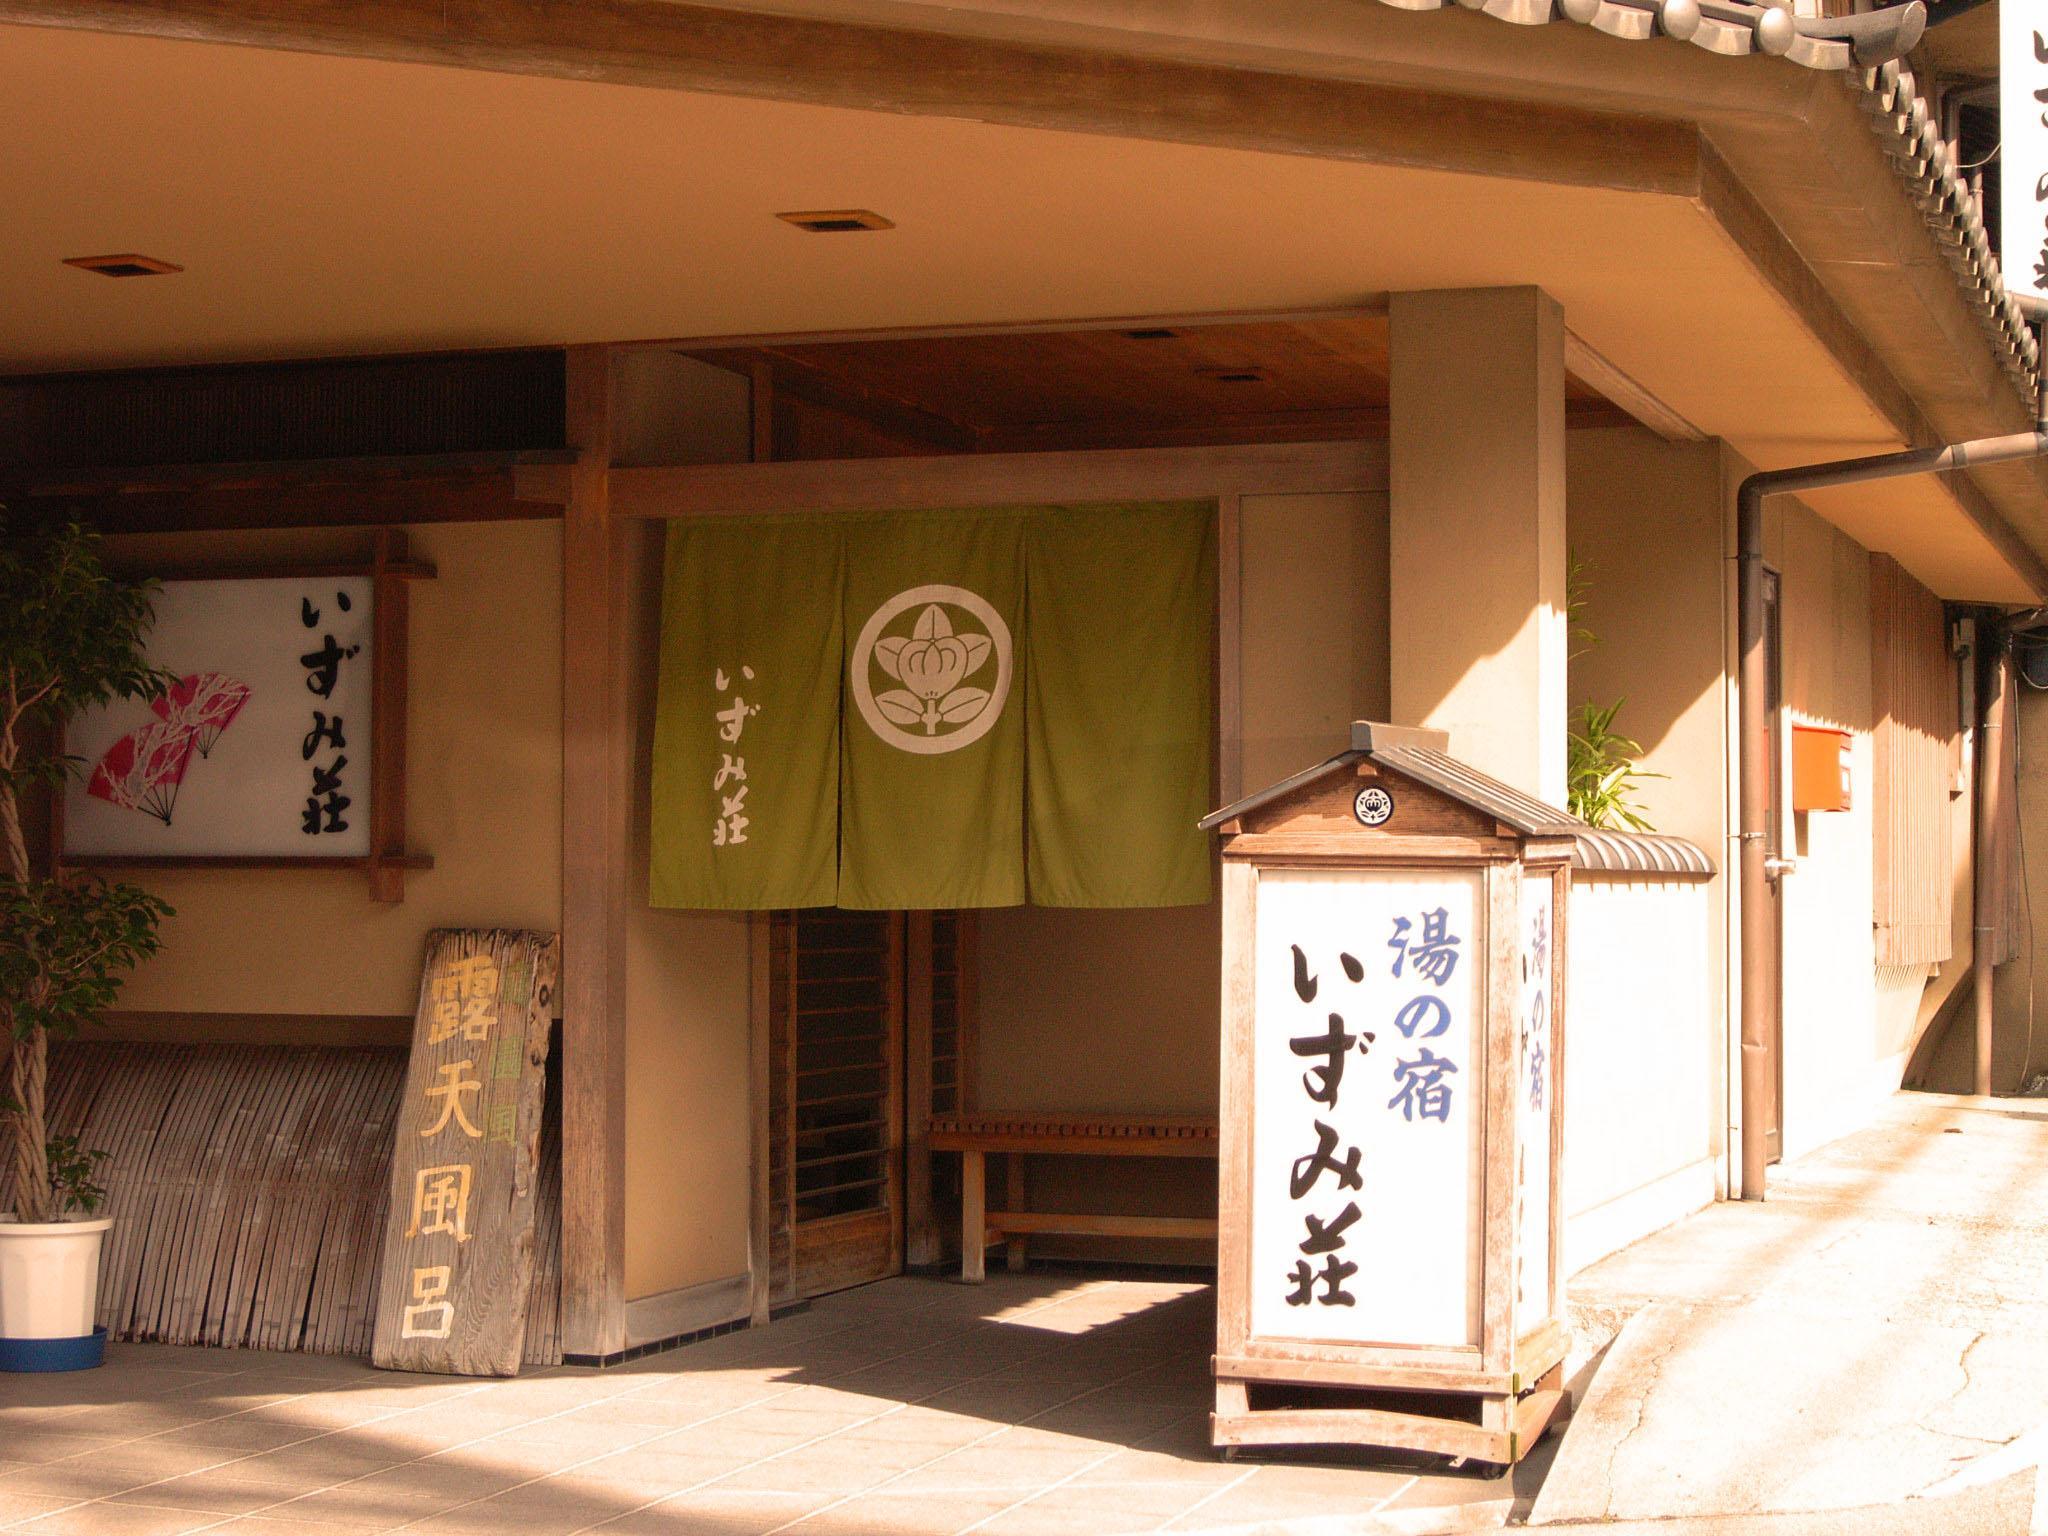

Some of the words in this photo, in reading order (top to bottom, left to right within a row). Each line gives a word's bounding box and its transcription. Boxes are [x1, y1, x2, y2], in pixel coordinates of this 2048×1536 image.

[300, 591, 361, 835] いずみ荘
[713, 665, 761, 846] いずみ荘
[1286, 943, 1376, 1307] いずみ荘
[1387, 907, 1461, 1123] 湯の宿
[402, 954, 498, 1339] 露天風呂
